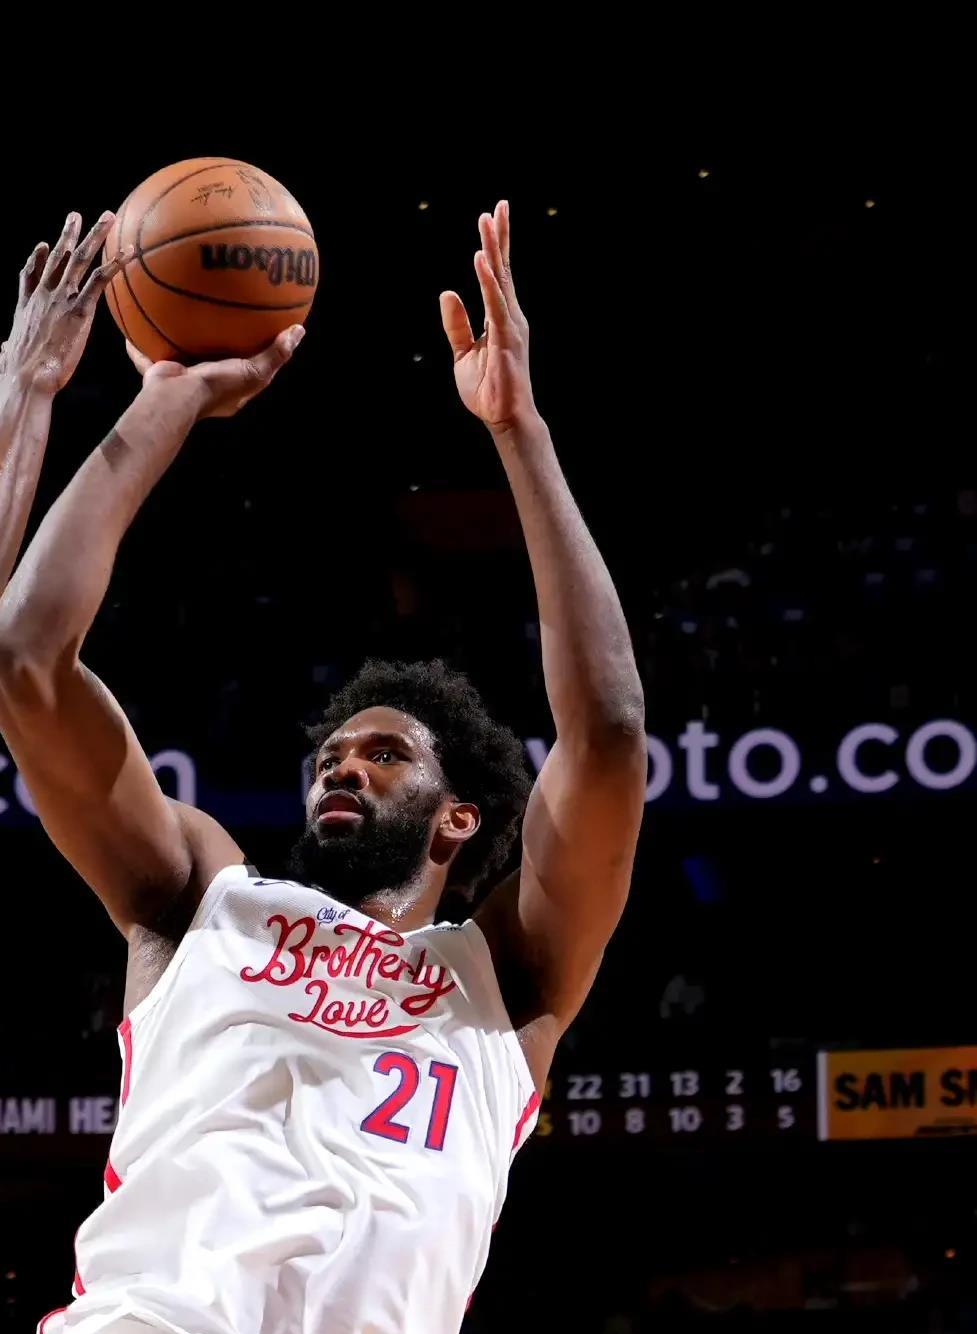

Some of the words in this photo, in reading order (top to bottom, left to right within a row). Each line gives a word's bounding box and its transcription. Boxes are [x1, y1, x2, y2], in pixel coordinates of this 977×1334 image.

[199, 244, 315, 287] Wilson
[240, 914, 456, 1016] Brotherly
[288, 980, 421, 1039] Love
[360, 1051, 459, 1152] 21
[567, 1075, 603, 1100] 22
[618, 1072, 651, 1099] 31
[669, 1070, 700, 1097] 13
[725, 1070, 744, 1095] 2
[770, 1068, 802, 1093] 16
[835, 1072, 926, 1112] SAM
[941, 1067, 977, 1107] S
[69, 1096, 120, 1135] HE
[568, 1109, 602, 1136] 10
[668, 1105, 703, 1133] 10
[725, 1104, 745, 1131] 3
